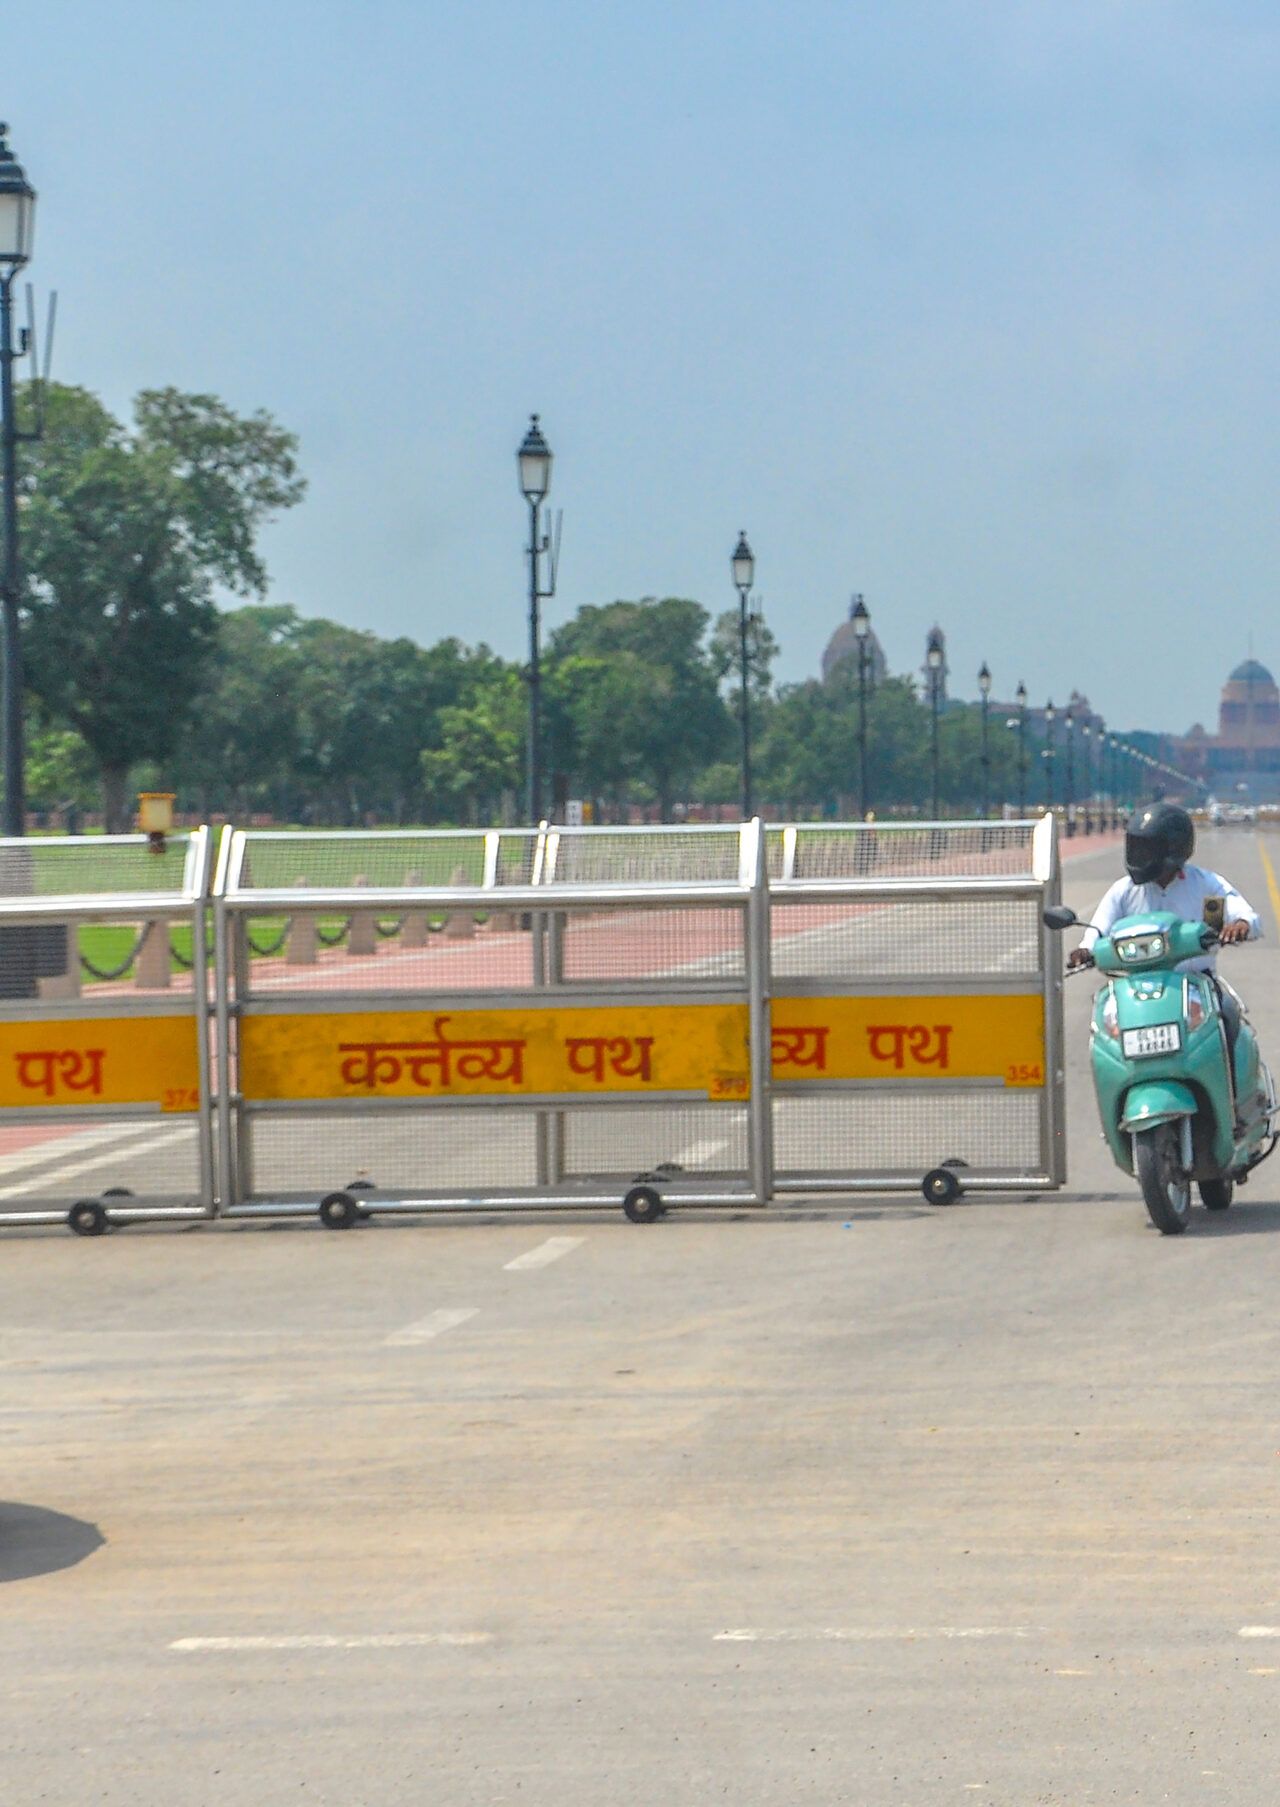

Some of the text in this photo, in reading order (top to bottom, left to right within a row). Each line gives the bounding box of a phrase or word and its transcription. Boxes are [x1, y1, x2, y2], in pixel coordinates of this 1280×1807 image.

[339, 1017, 654, 1088] कर्त्तव्य पथ
[867, 1025, 952, 1069] पथ
[14, 1049, 106, 1096] पथ
[1007, 1064, 1041, 1081] 354
